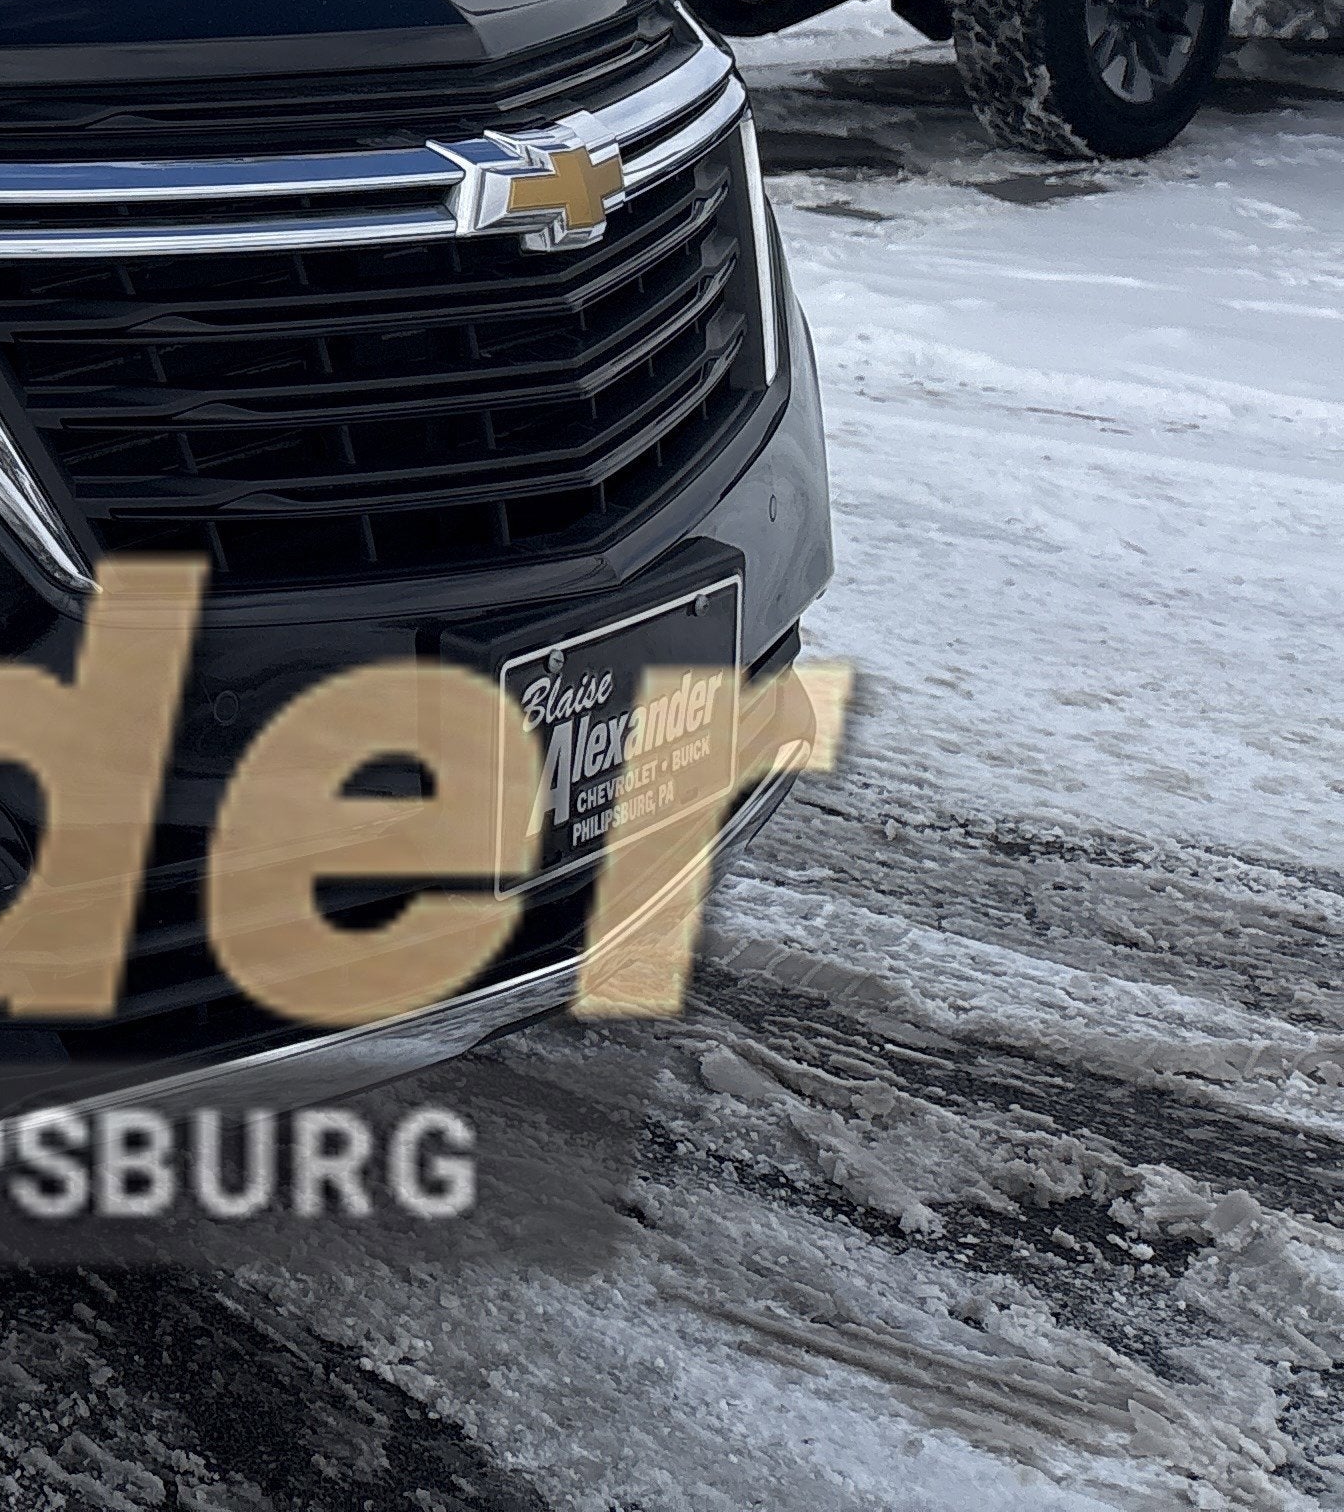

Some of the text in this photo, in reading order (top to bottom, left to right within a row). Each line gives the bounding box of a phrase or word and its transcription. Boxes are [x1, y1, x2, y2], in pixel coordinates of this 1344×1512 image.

[520, 669, 613, 733] Blaise
[525, 668, 724, 838] Alexander
[575, 735, 711, 814] CHEVROLET BUICK
[658, 780, 675, 808] PA
